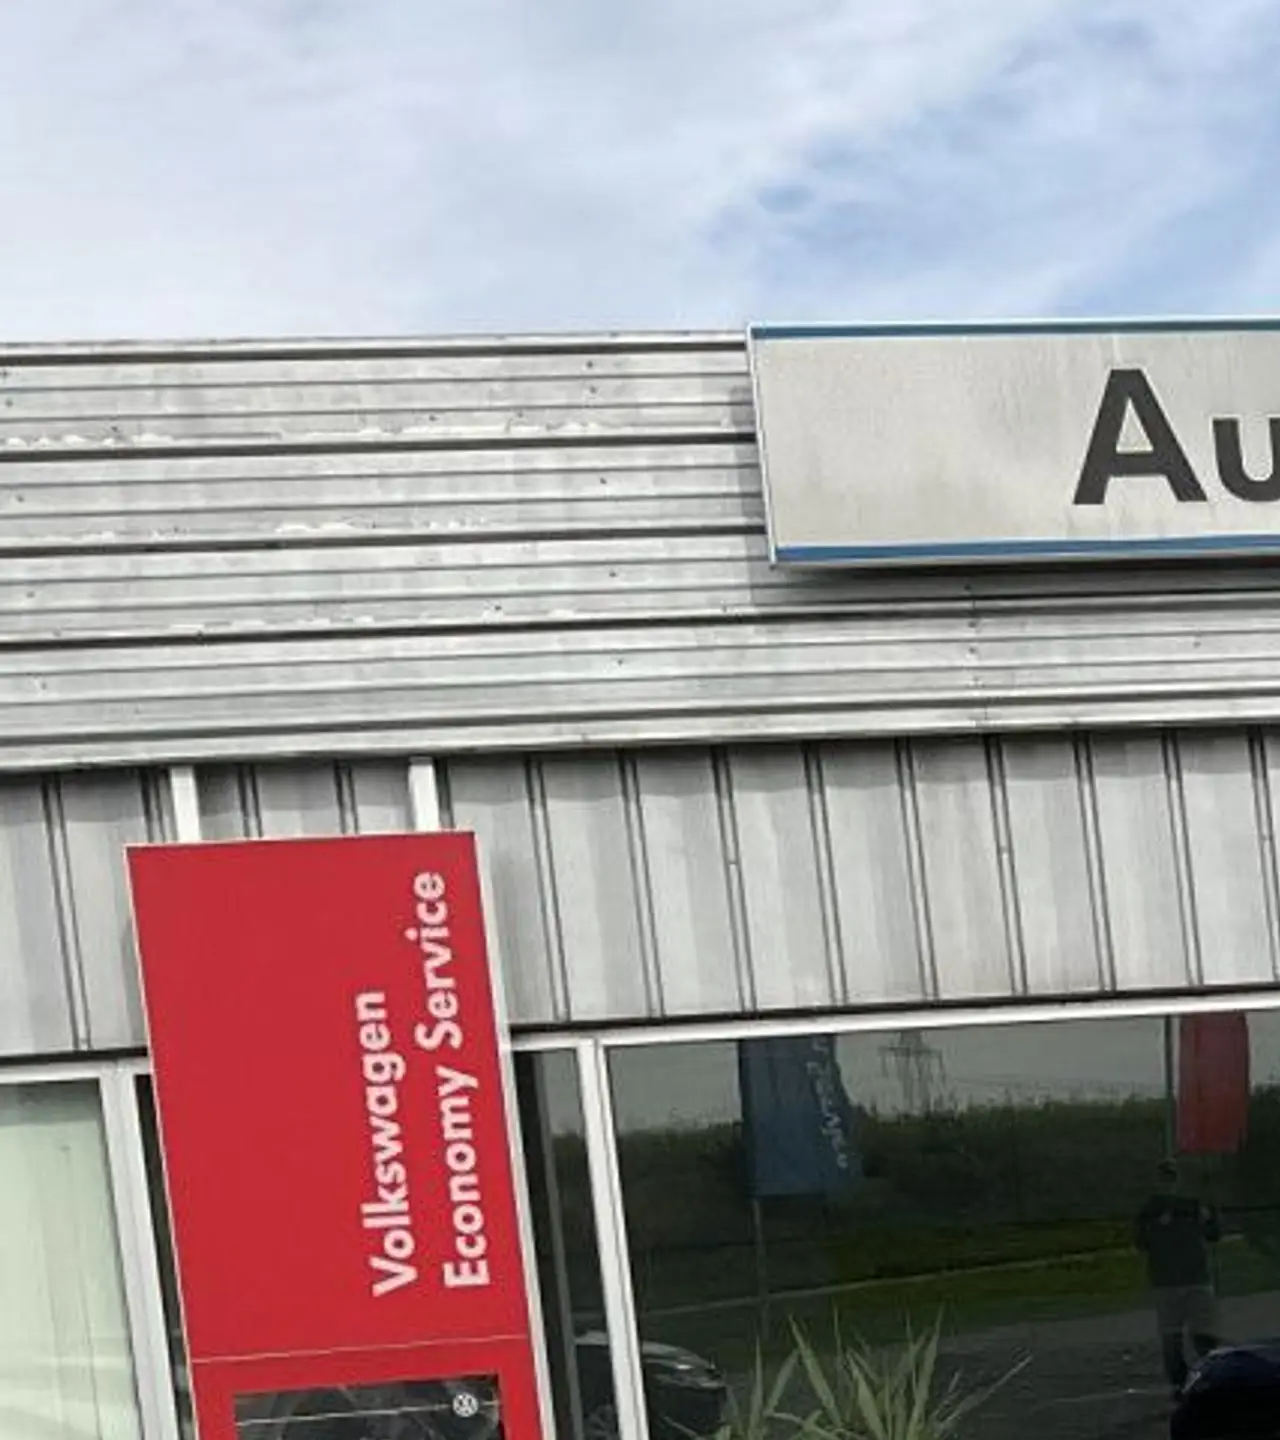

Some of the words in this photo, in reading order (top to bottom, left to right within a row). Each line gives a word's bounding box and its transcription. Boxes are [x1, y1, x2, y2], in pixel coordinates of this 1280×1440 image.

[405, 871, 463, 1050] Service
[356, 990, 418, 1297] Volkswagen
[436, 1065, 491, 1288] Economy
